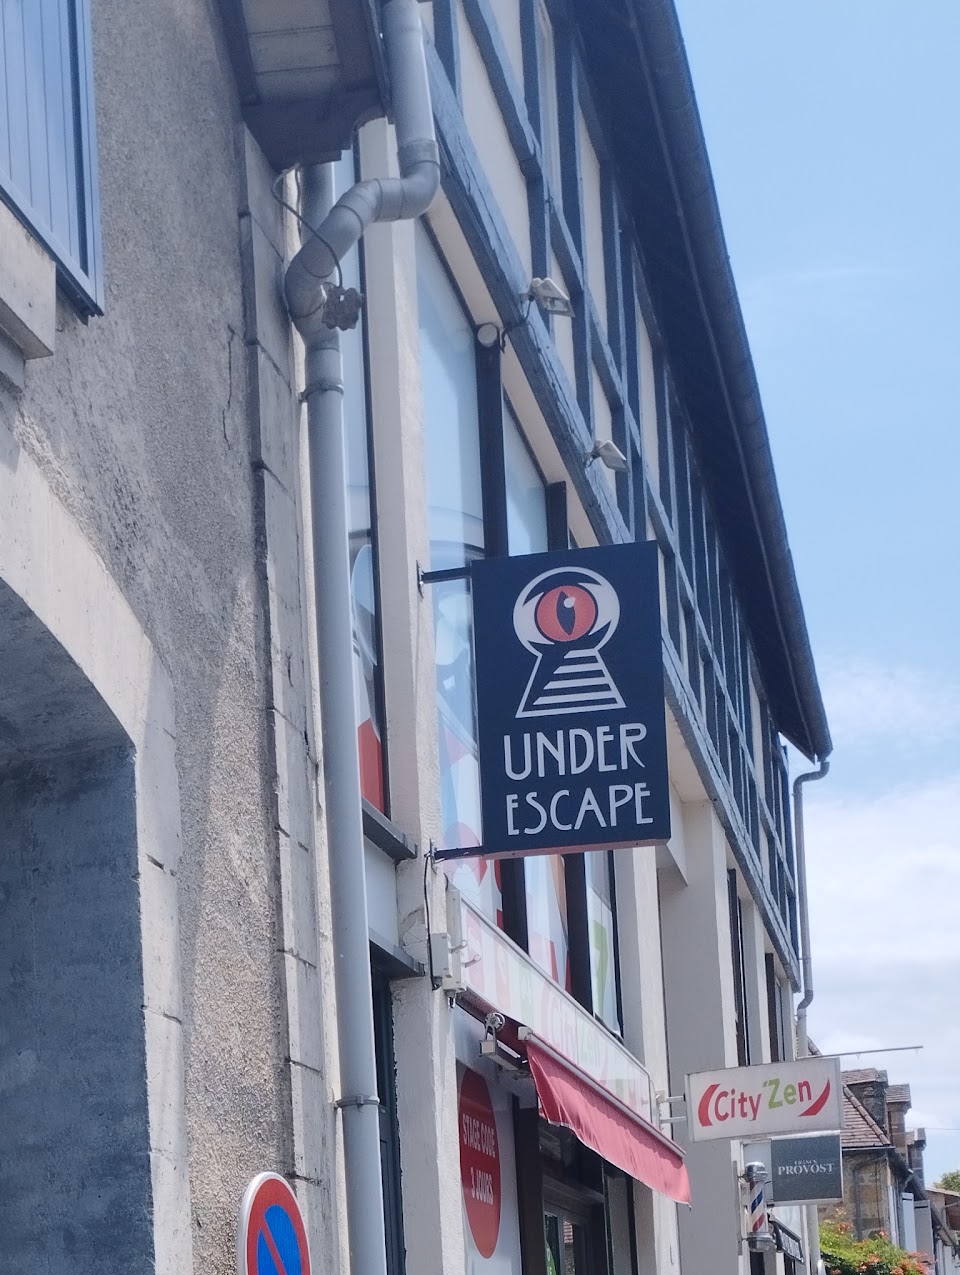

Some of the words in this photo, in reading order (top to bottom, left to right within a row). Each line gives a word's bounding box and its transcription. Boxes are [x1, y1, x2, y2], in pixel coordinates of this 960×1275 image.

[504, 723, 647, 781] UNDER
[506, 782, 654, 836] ESCAPE
[714, 1087, 762, 1122] City
[763, 1078, 812, 1109] Zen
[462, 1112, 481, 1152] STAGE
[480, 1121, 496, 1159] CODE
[475, 1171, 495, 1206] JOURS
[778, 1163, 835, 1176] PROVOST
